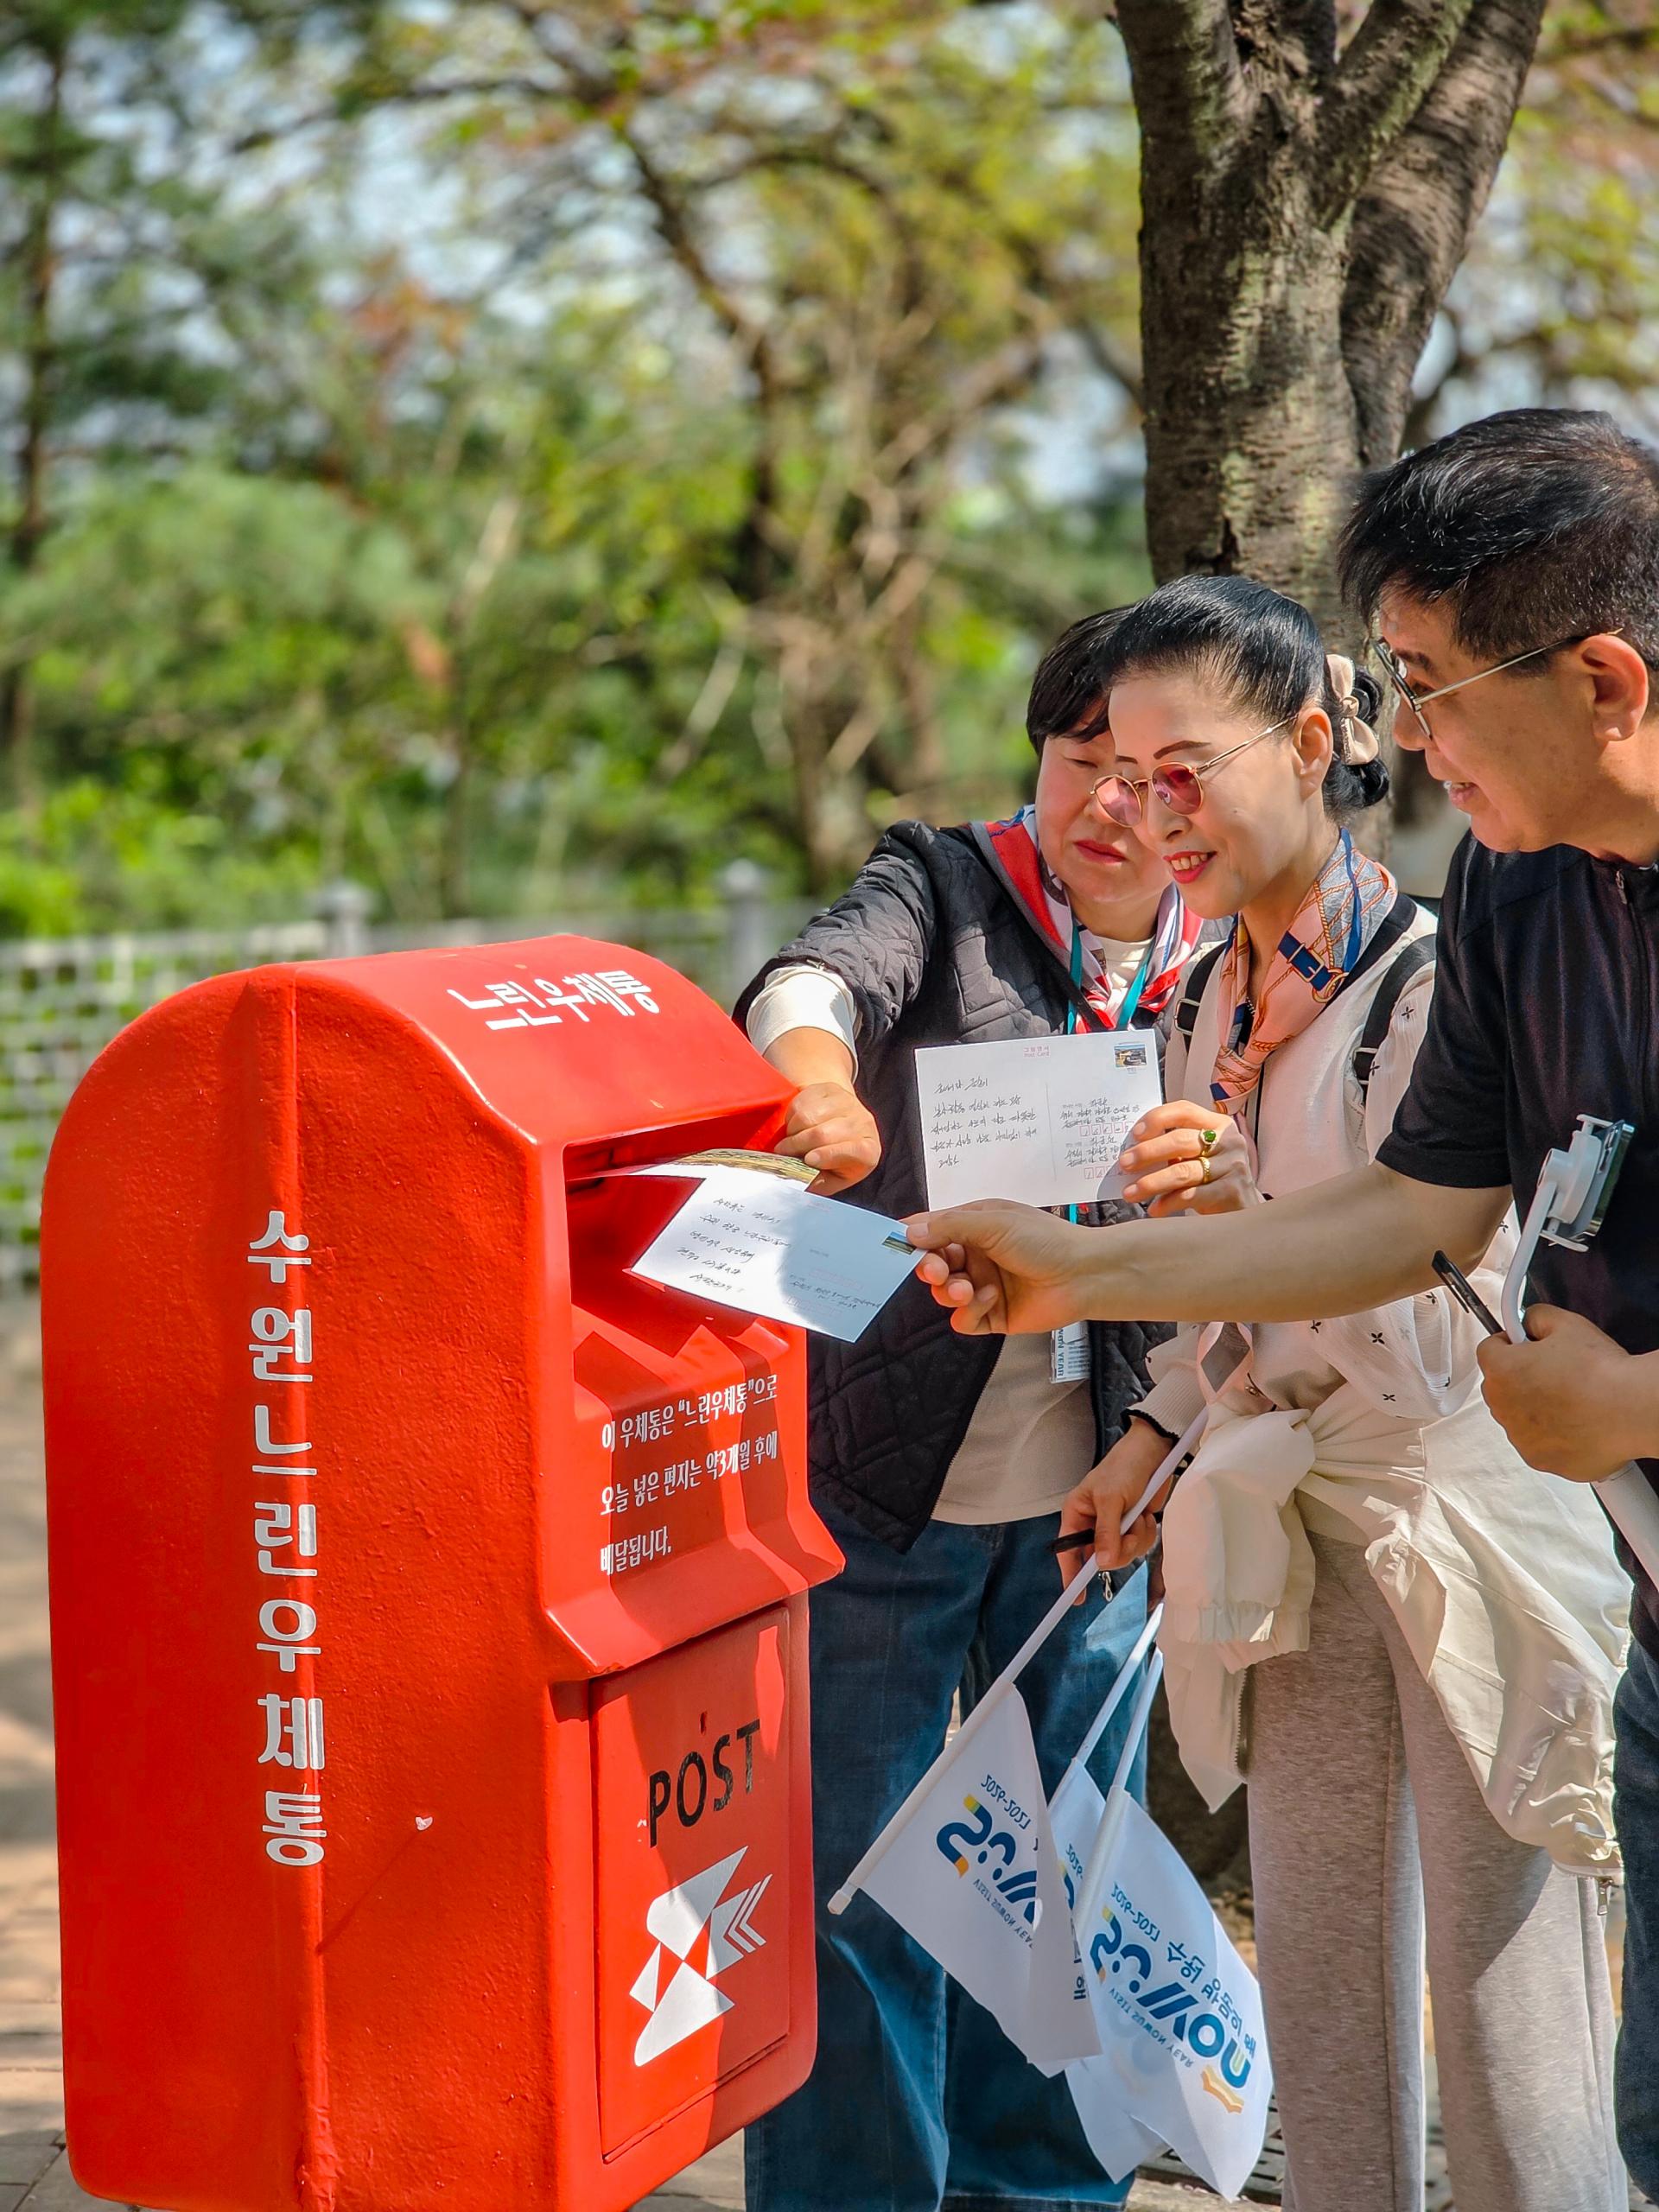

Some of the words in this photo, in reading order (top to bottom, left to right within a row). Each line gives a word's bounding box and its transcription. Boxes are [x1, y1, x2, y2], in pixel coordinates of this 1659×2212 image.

[446, 969, 660, 1030] 느린우체통
[601, 1421, 616, 1452] 이
[620, 1407, 675, 1449] 우체통은
[600, 1484, 629, 1516] 오늘
[632, 1471, 661, 1508] 넣은
[663, 1459, 702, 1496] 편지는
[705, 1439, 751, 1480] 약3개월
[753, 1430, 778, 1465] 후에
[247, 1211, 327, 1868] 수원느린우체통
[600, 1525, 672, 1576] 배달됩니다.
[649, 1719, 760, 1848] POST
